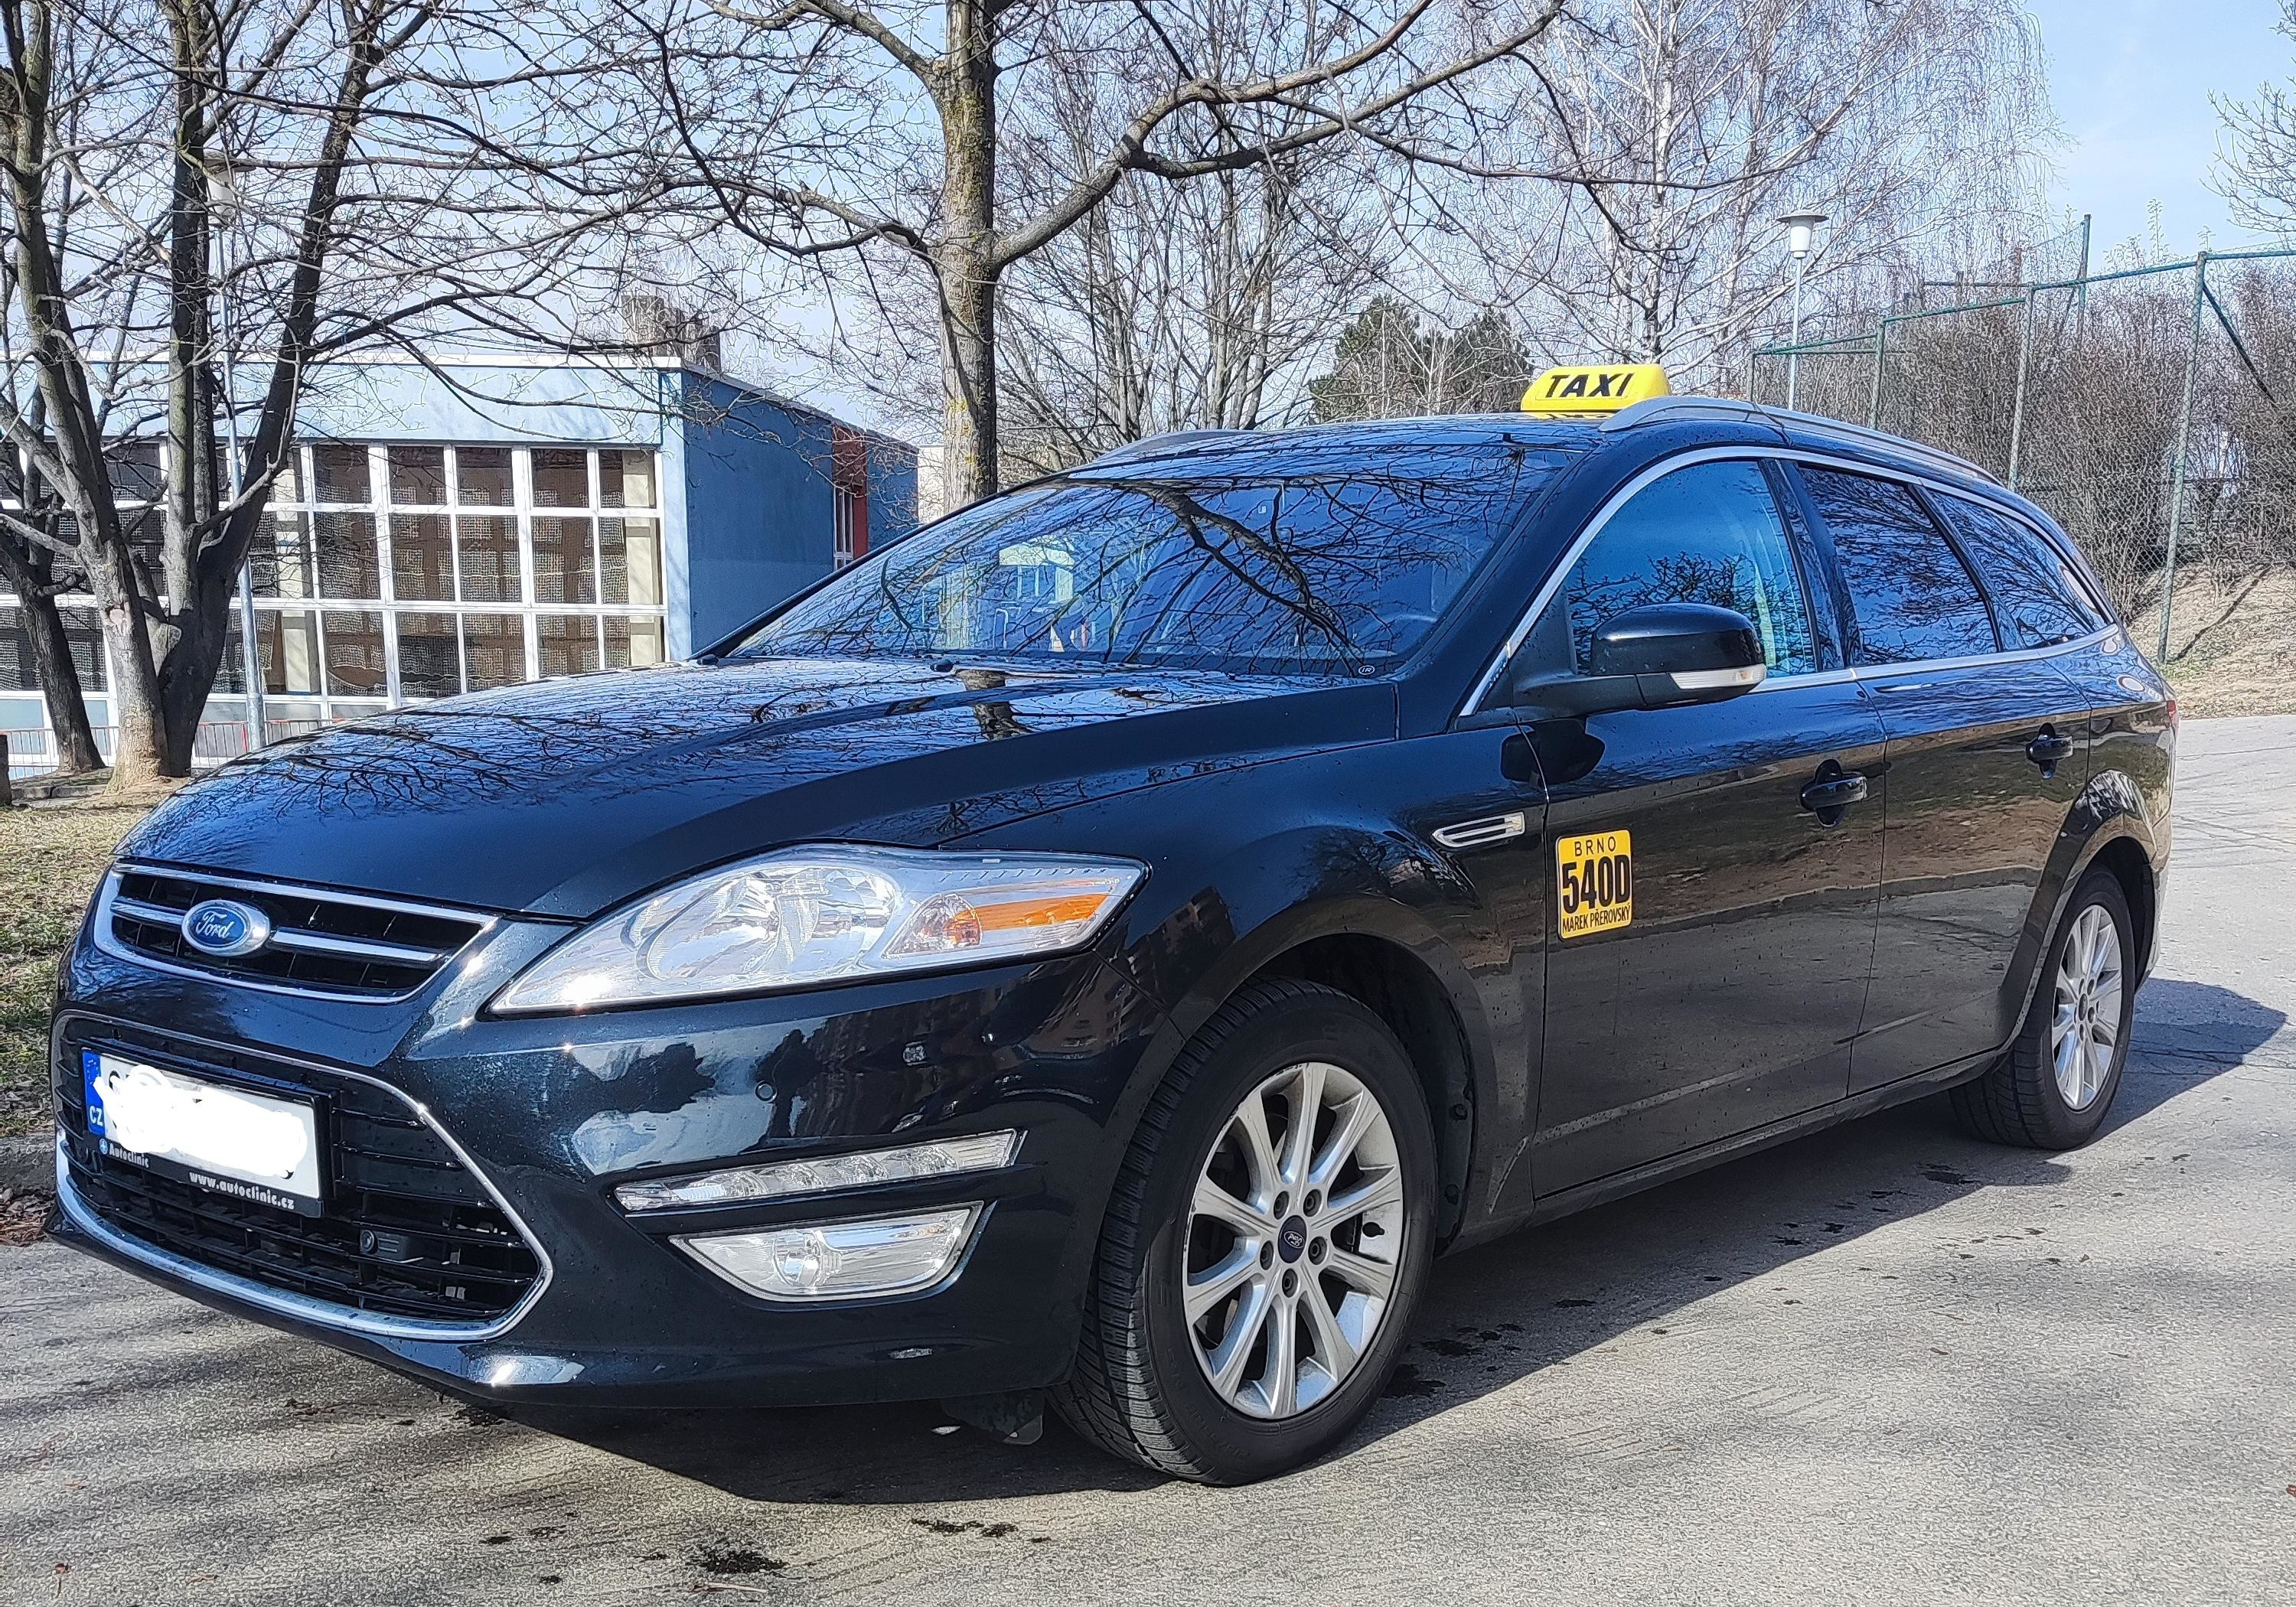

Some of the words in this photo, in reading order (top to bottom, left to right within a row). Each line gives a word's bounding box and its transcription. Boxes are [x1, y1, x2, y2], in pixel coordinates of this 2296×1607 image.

[1545, 373, 1636, 398] TAXI
[1574, 836, 1616, 856] BRNO
[1562, 854, 1631, 914] 540D
[196, 911, 235, 938] Ford
[1562, 914, 1589, 933] MAREK
[1590, 902, 1631, 927] PŘEROVSKÝ
[89, 1105, 103, 1127] CZ
[109, 1143, 149, 1169] Autoclinic
[189, 1172, 295, 1210] www.autoclinic.cz
